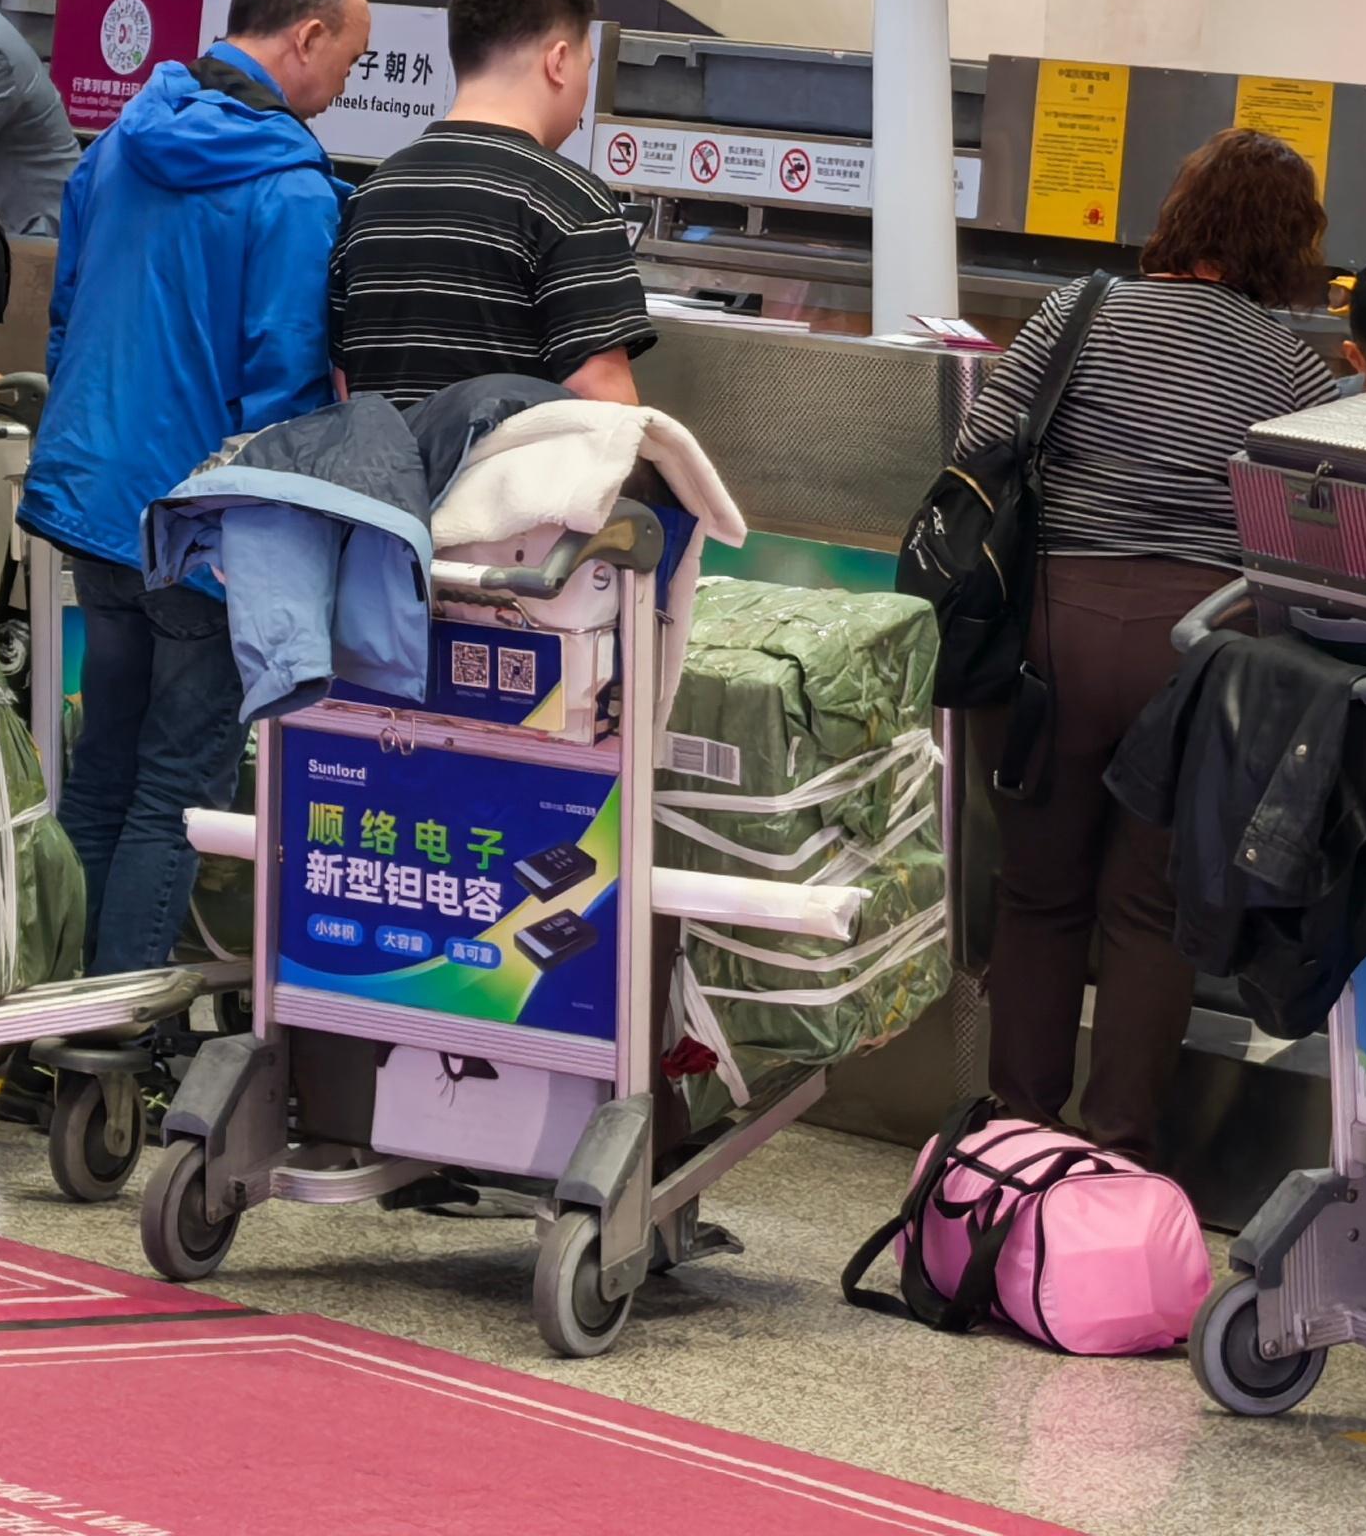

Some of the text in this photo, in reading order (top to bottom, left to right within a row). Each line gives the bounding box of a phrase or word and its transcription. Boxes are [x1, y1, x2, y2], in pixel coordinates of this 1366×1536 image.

[371, 95, 411, 118] facing
[413, 102, 435, 117] out
[308, 758, 366, 780] Sunlord
[307, 801, 505, 870] 顺络电子
[305, 849, 503, 923] 新型钽电容
